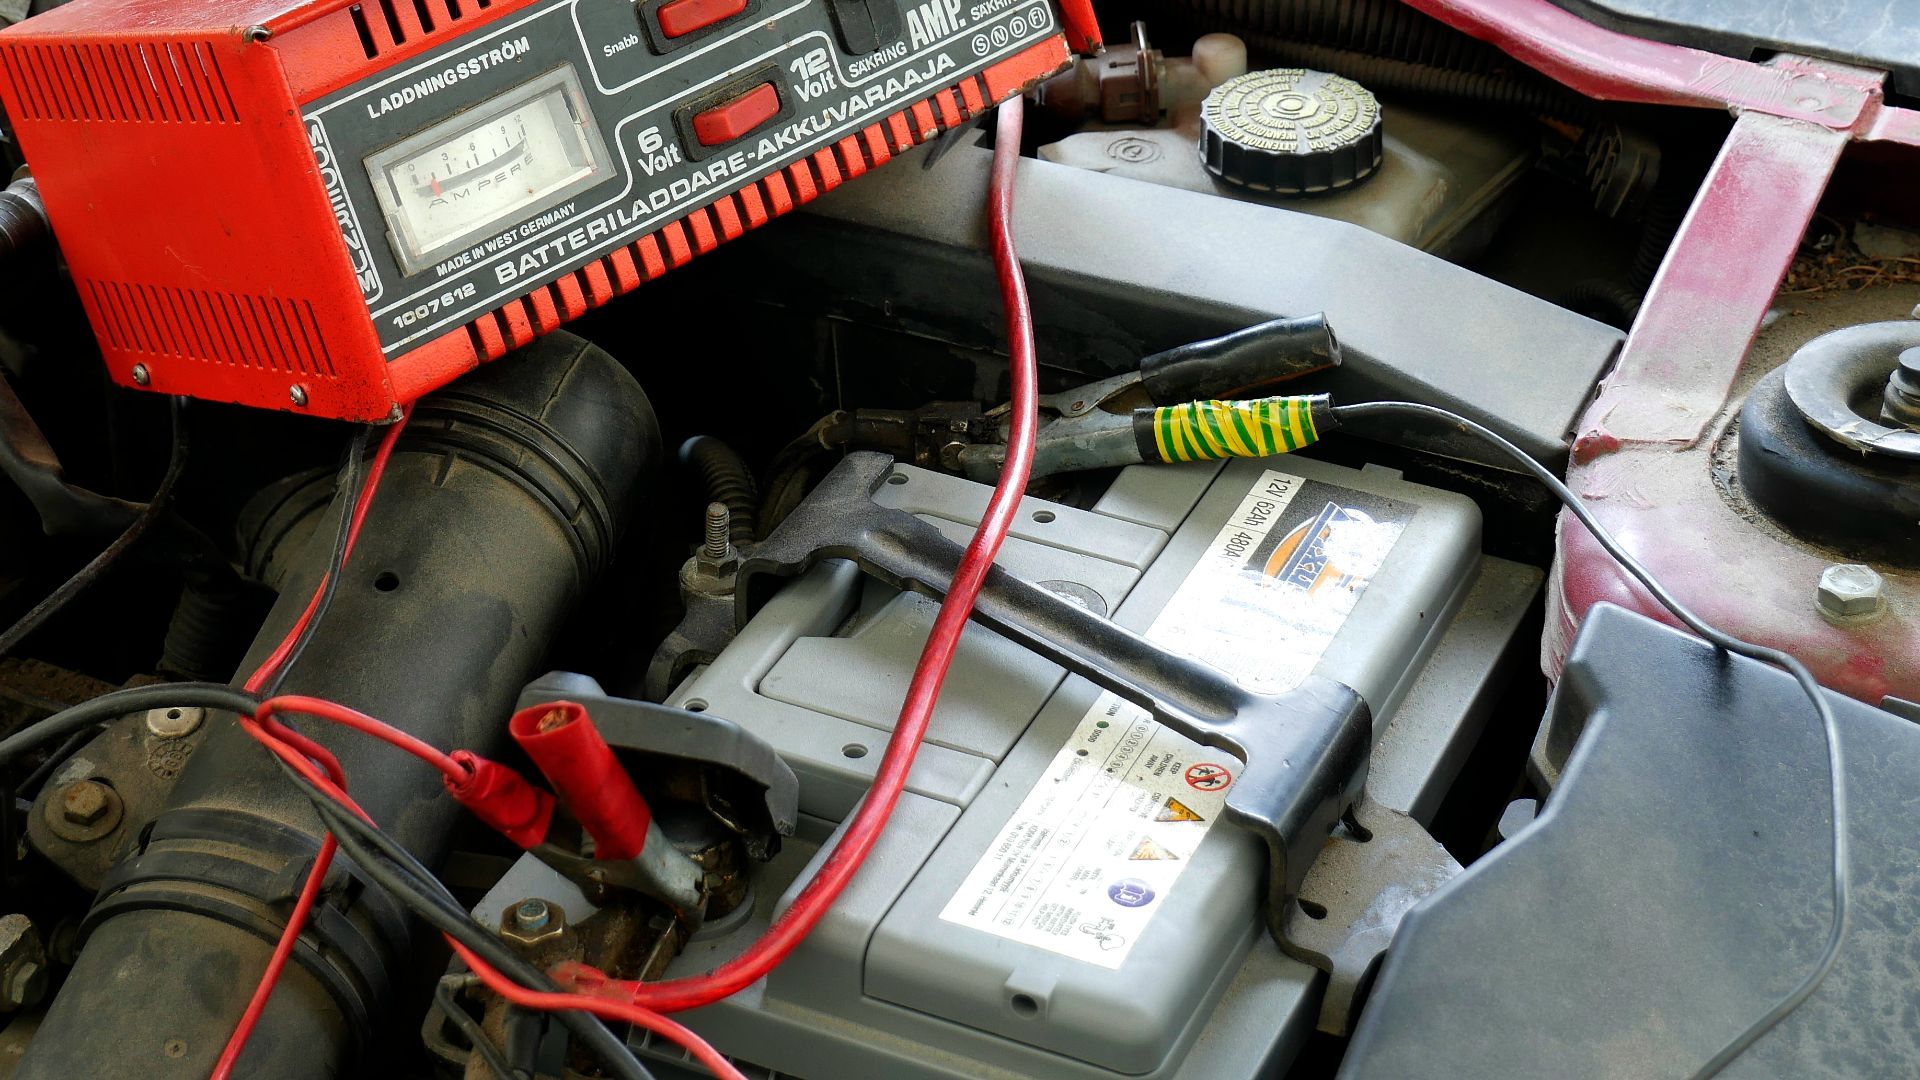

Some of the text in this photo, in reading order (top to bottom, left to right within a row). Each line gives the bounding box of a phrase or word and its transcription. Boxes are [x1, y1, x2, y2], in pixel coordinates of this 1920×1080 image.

[603, 33, 640, 57] Snabb
[849, 41, 908, 78] SÄKRING
[367, 36, 531, 119] LADDNINGSSTRÖM
[788, 46, 831, 83] 12
[793, 67, 839, 103] Volt
[441, 153, 449, 161] 3
[469, 142, 476, 151] 6
[500, 125, 506, 135] 9
[638, 126, 664, 154] 6
[495, 53, 956, 285] BATTERILADDARE-AKKUVARAAJA
[638, 145, 682, 177] Volt
[429, 152, 535, 209] AMPERE
[435, 202, 576, 277] MADE IN WEST GERMANY
[393, 282, 477, 329] 1007612
[1223, 478, 1291, 559] 12V 62Ah 480A
